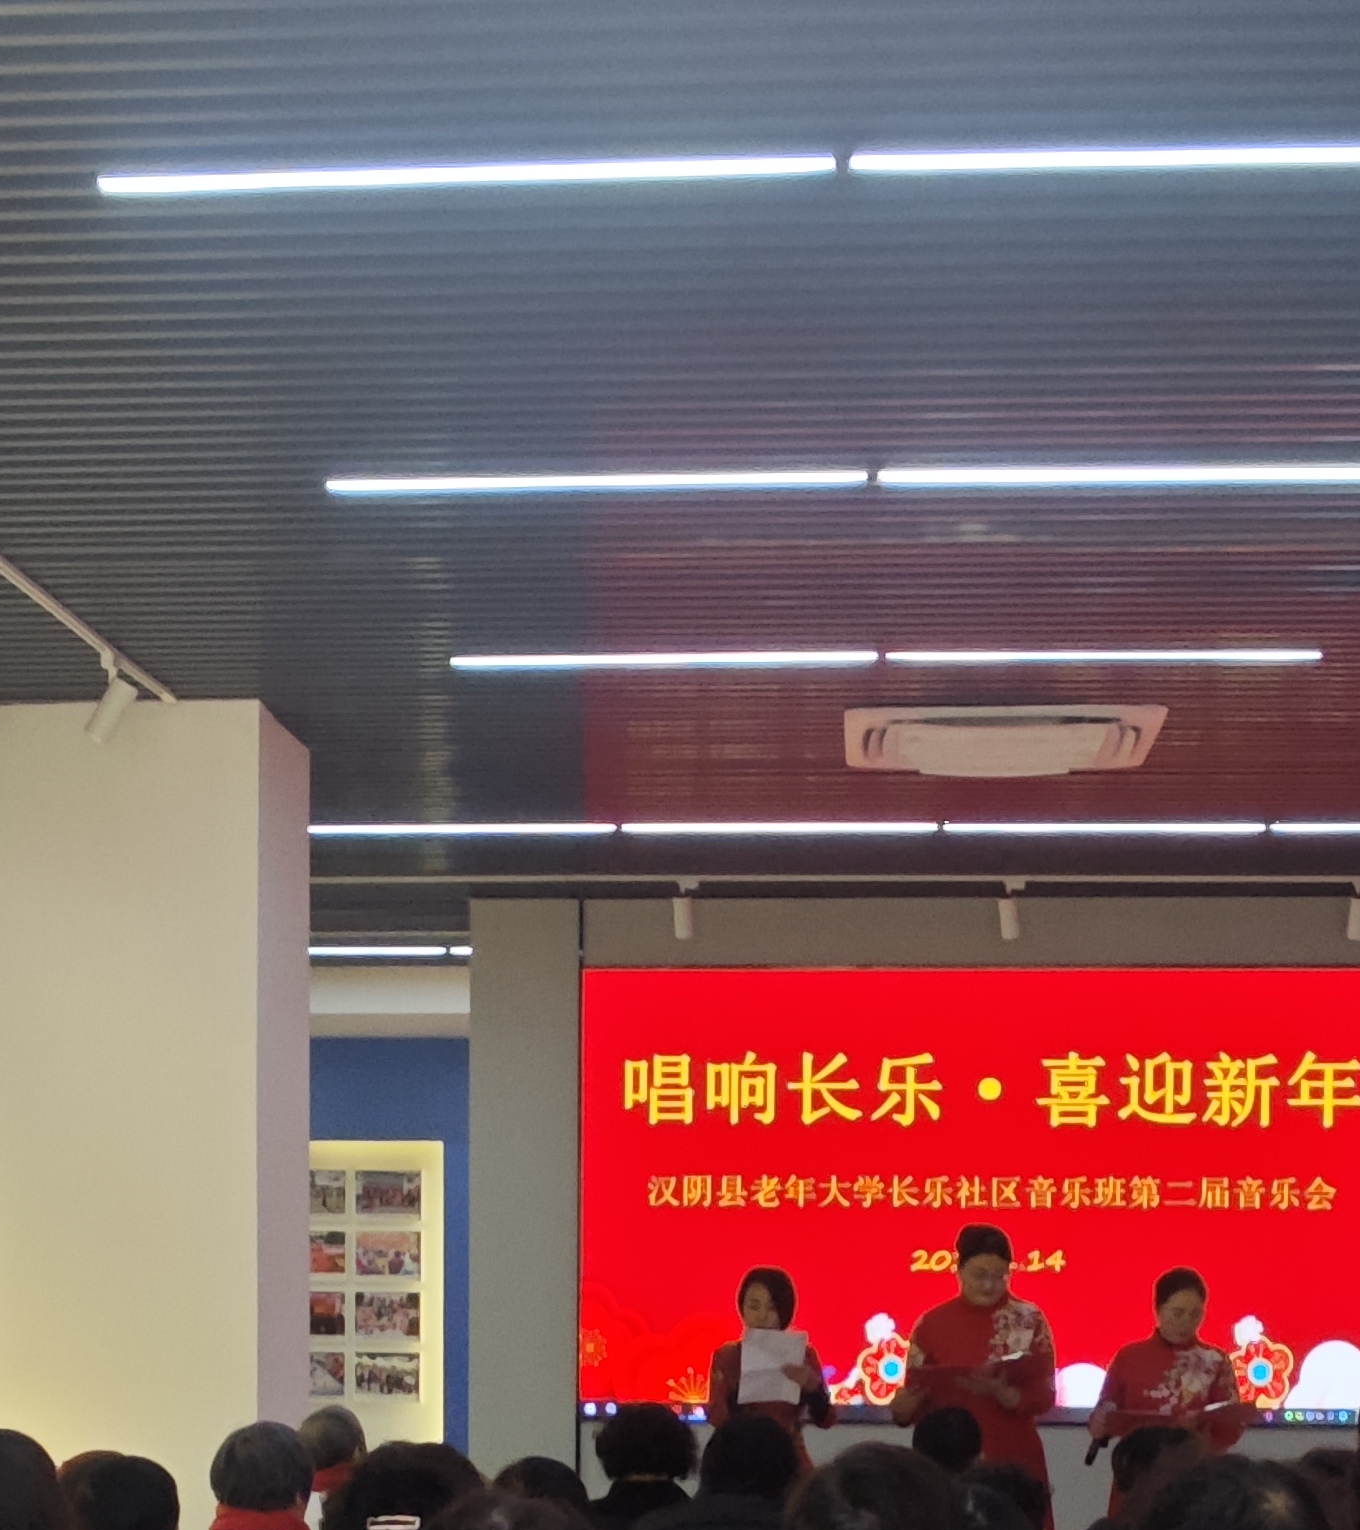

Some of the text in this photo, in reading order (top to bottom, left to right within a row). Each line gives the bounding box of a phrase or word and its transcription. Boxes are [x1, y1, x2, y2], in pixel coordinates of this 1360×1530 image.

[647, 1173, 1338, 1211] 汉阴县老年大学长乐社区音乐班第二届音乐会
